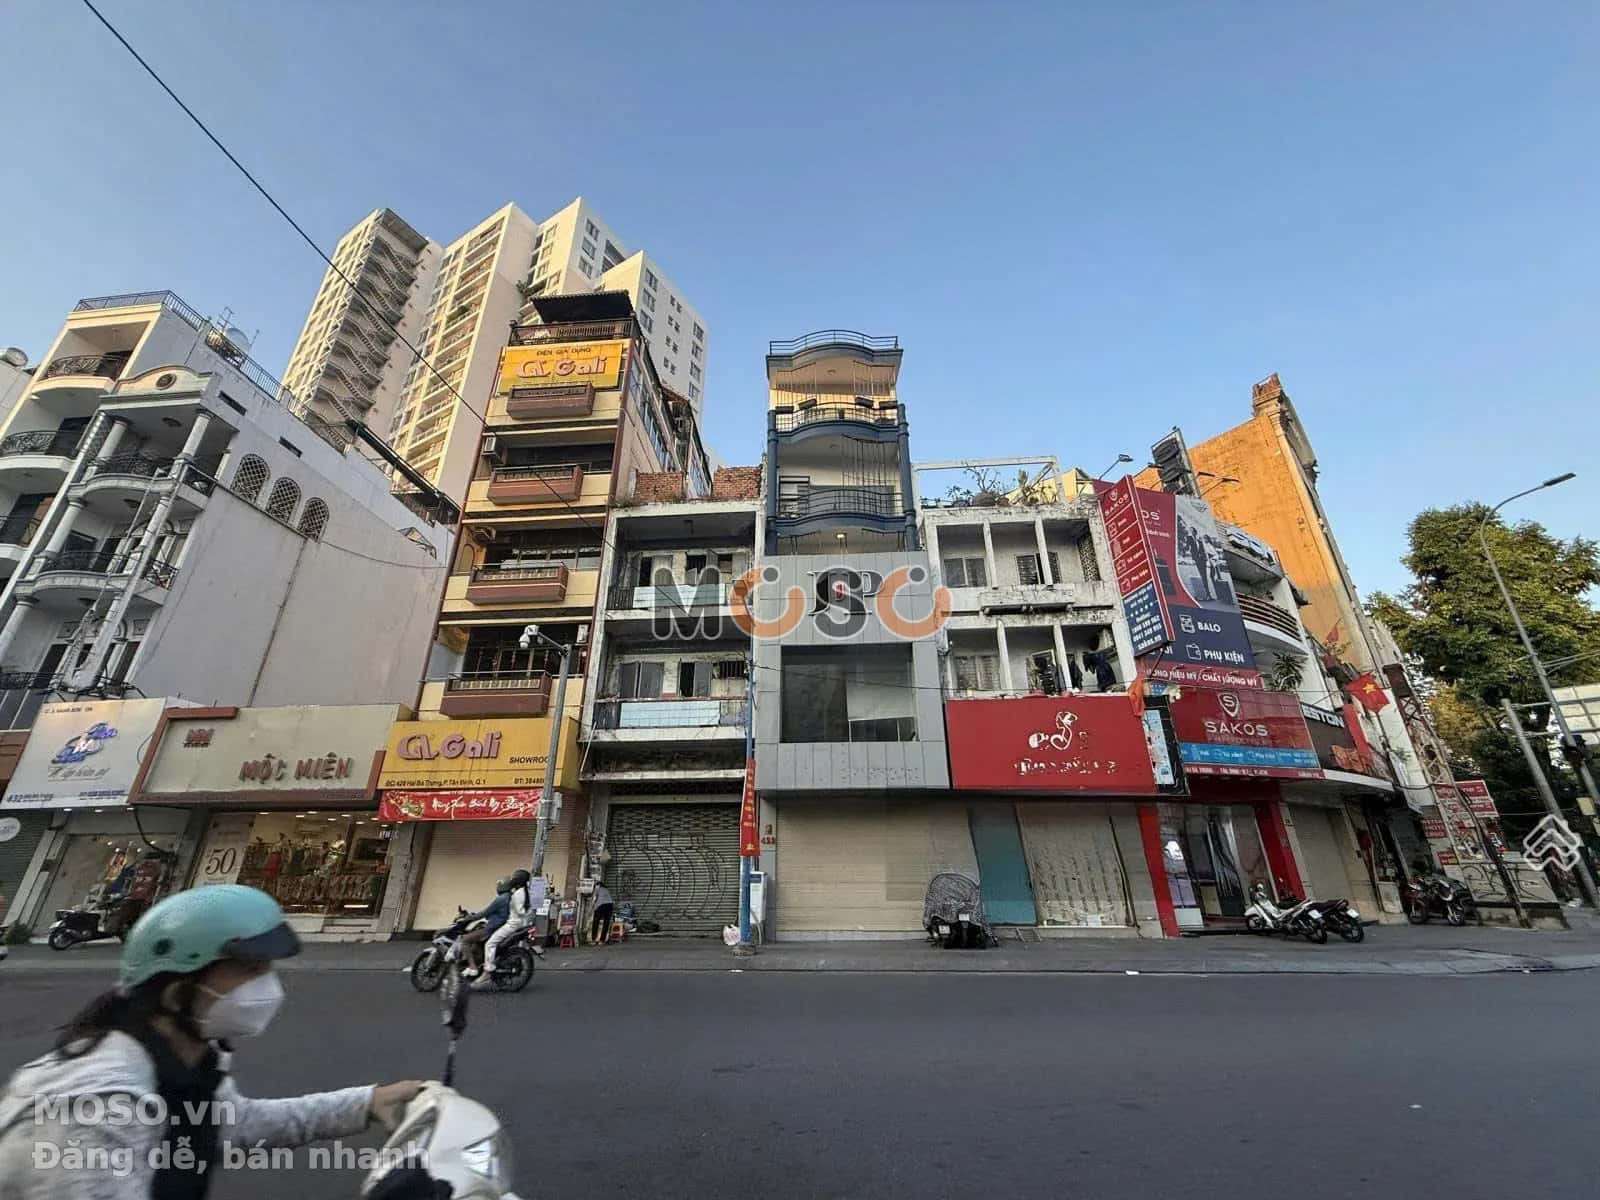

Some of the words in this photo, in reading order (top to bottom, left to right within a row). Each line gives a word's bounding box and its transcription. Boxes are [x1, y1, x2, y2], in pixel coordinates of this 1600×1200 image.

[1197, 622, 1221, 633] BALO
[1204, 649, 1222, 663] PHỤ
[1224, 650, 1245, 664] KIỆN
[1204, 721, 1268, 737] SAKOS
[239, 753, 287, 784] MỘC
[294, 752, 354, 780] MIÊN
[205, 848, 237, 875] 50
